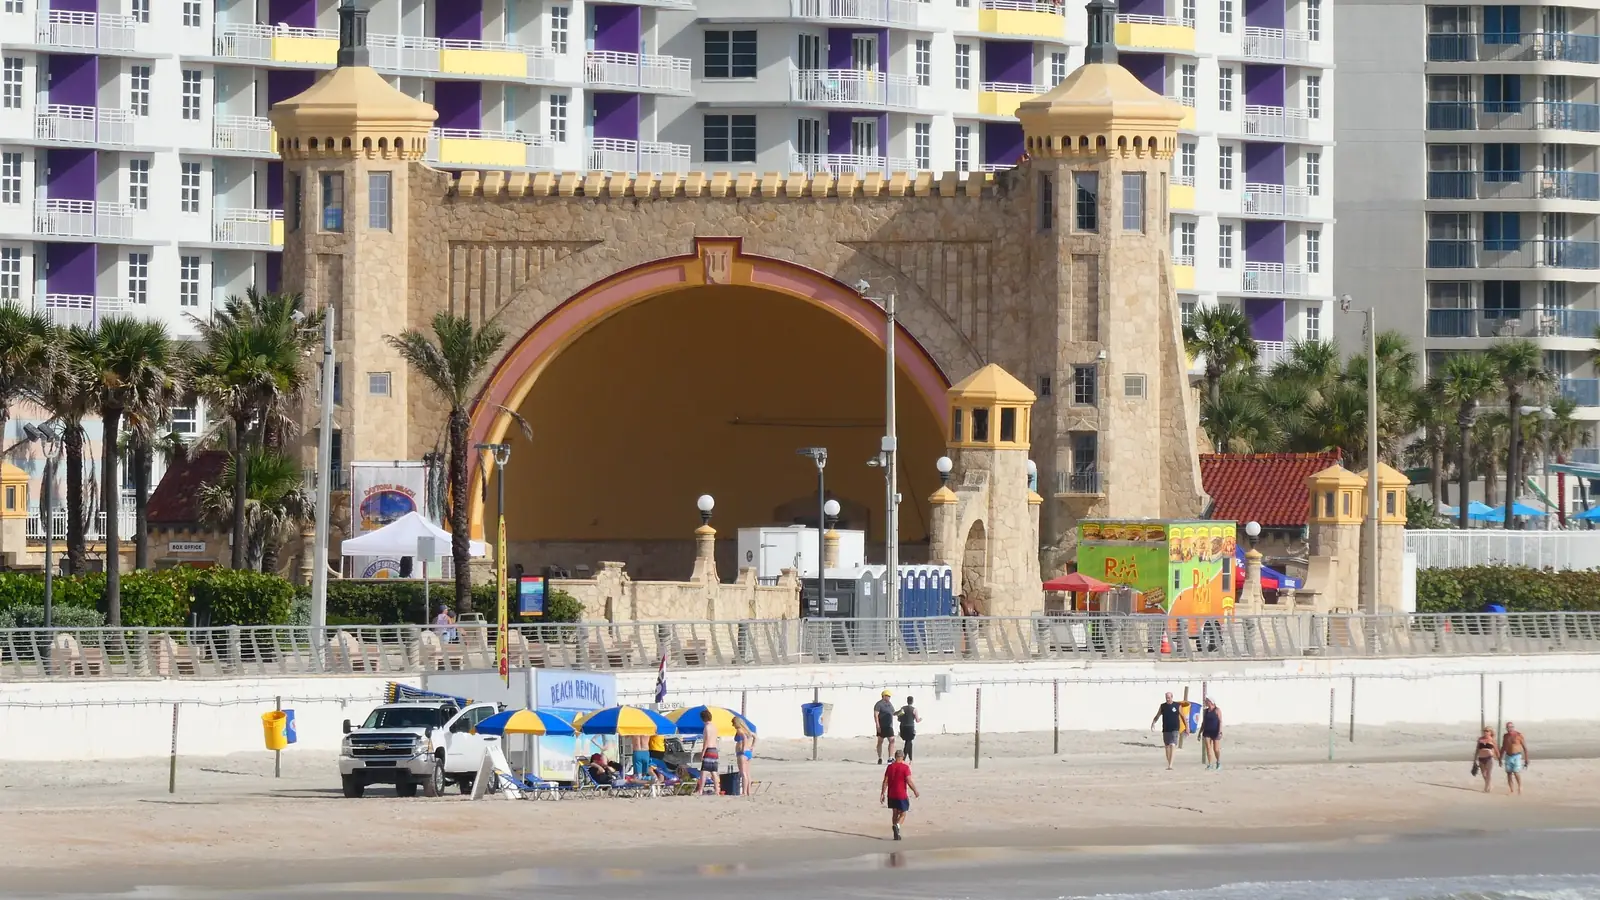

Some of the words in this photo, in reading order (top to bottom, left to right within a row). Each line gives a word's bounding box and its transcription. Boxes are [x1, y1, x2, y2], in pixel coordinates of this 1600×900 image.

[364, 484, 392, 496] DAYTONA
[396, 485, 416, 498] BEACH
[551, 680, 573, 705] BEACH
[576, 680, 605, 707] RENTALS
